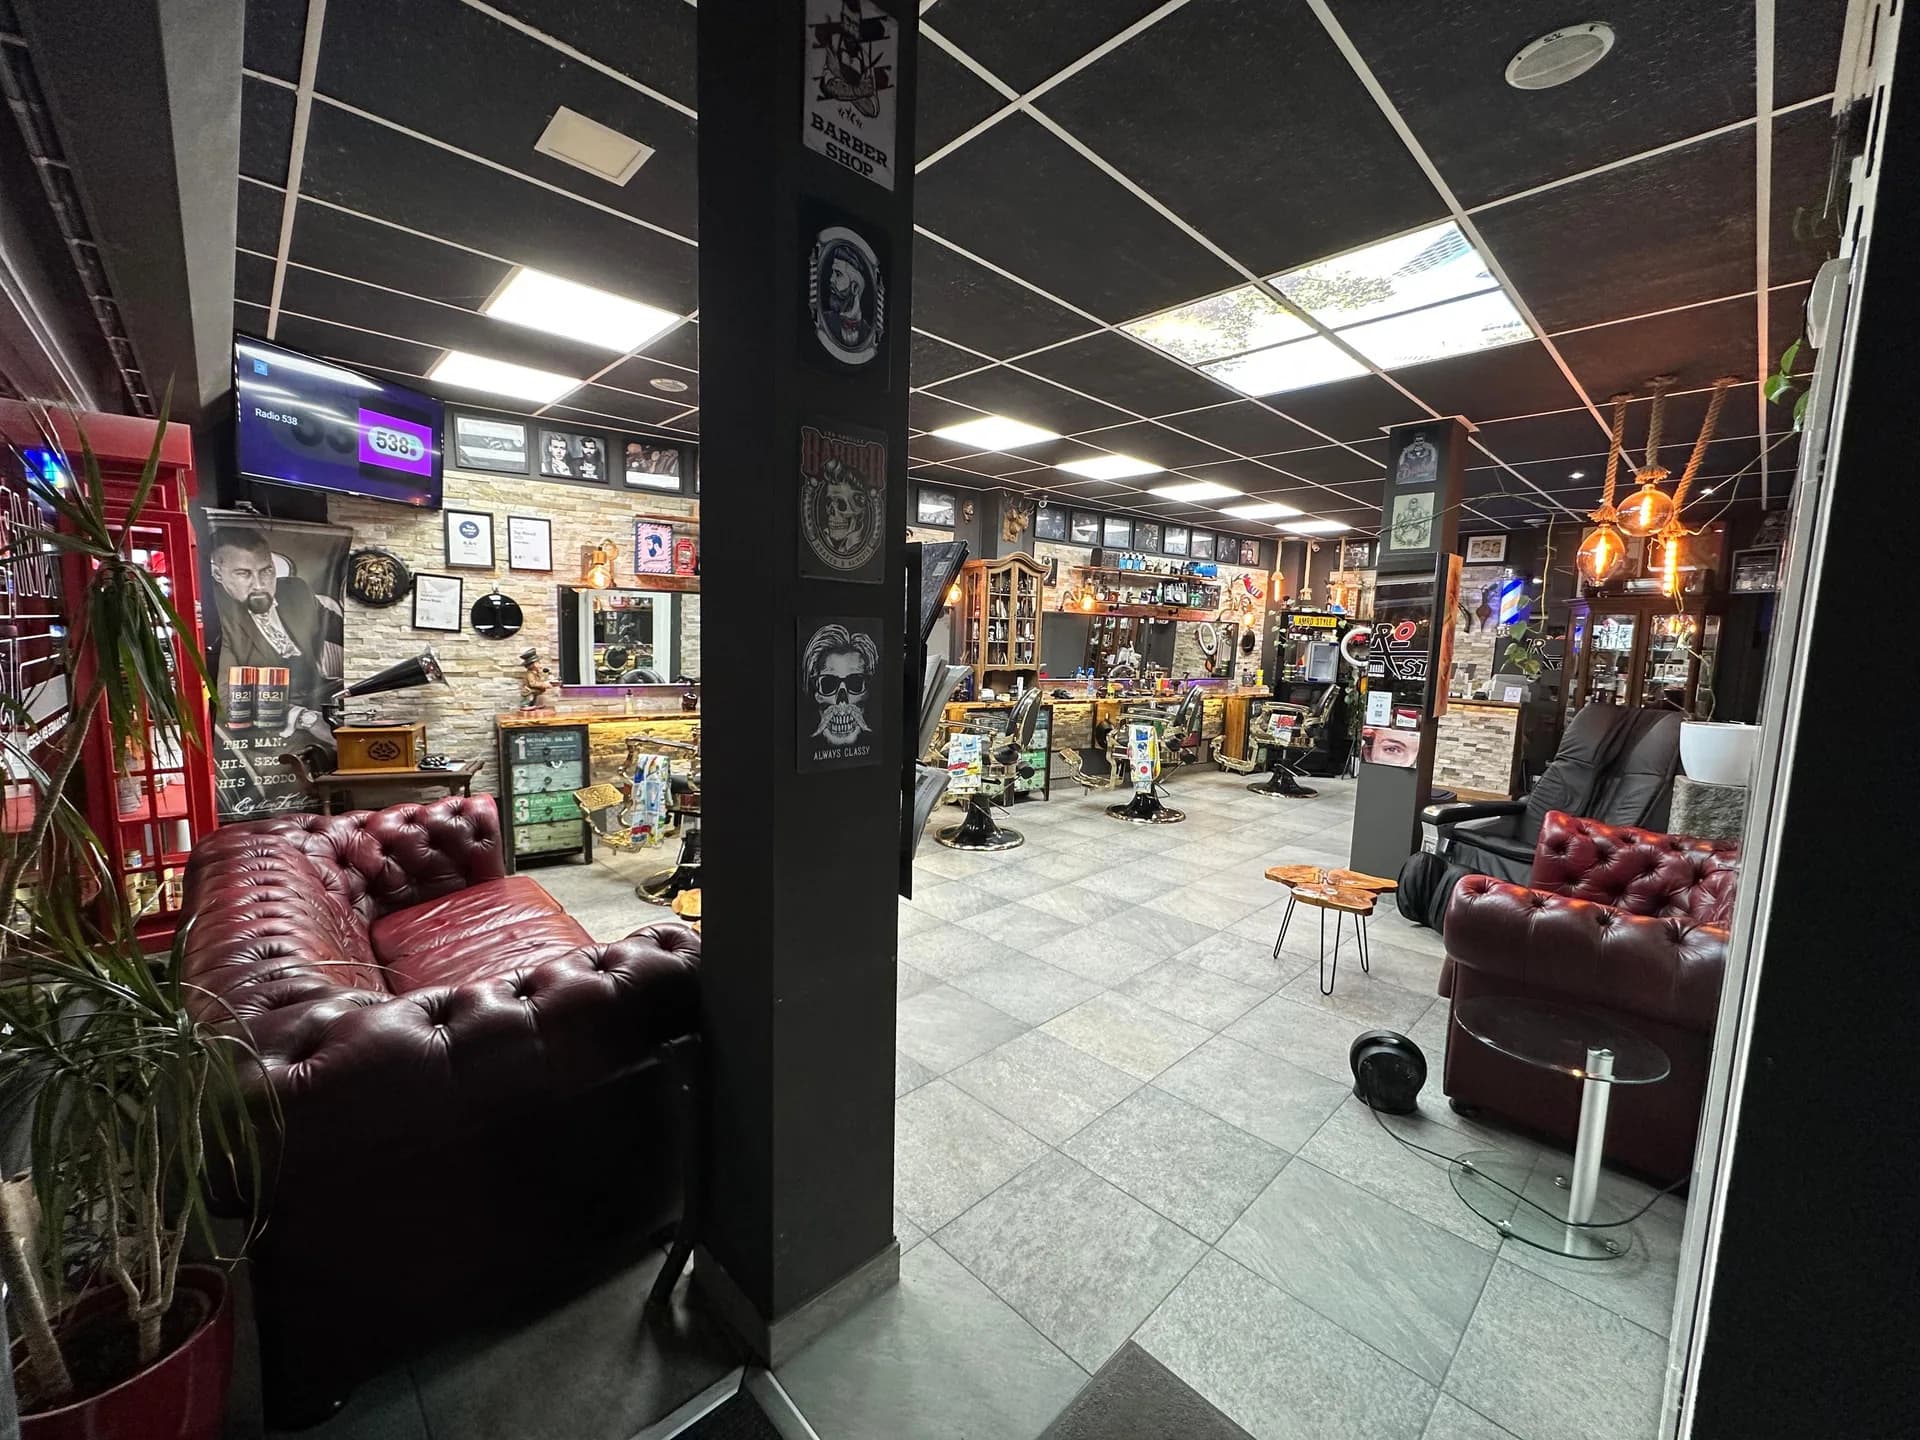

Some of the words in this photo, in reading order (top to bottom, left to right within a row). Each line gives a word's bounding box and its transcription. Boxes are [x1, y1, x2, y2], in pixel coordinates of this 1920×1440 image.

[810, 112, 888, 168] BARBER
[825, 141, 874, 176] SHOP
[255, 407, 281, 422] Radio
[281, 413, 298, 426] 538
[376, 430, 409, 455] 538
[223, 739, 248, 750] THE
[255, 737, 287, 748] MAN.
[813, 748, 841, 761] ALWAYS
[844, 746, 871, 758] CLASSY
[220, 759, 247, 770] HIS
[219, 777, 246, 789] HIS
[253, 773, 297, 786] DEODO
